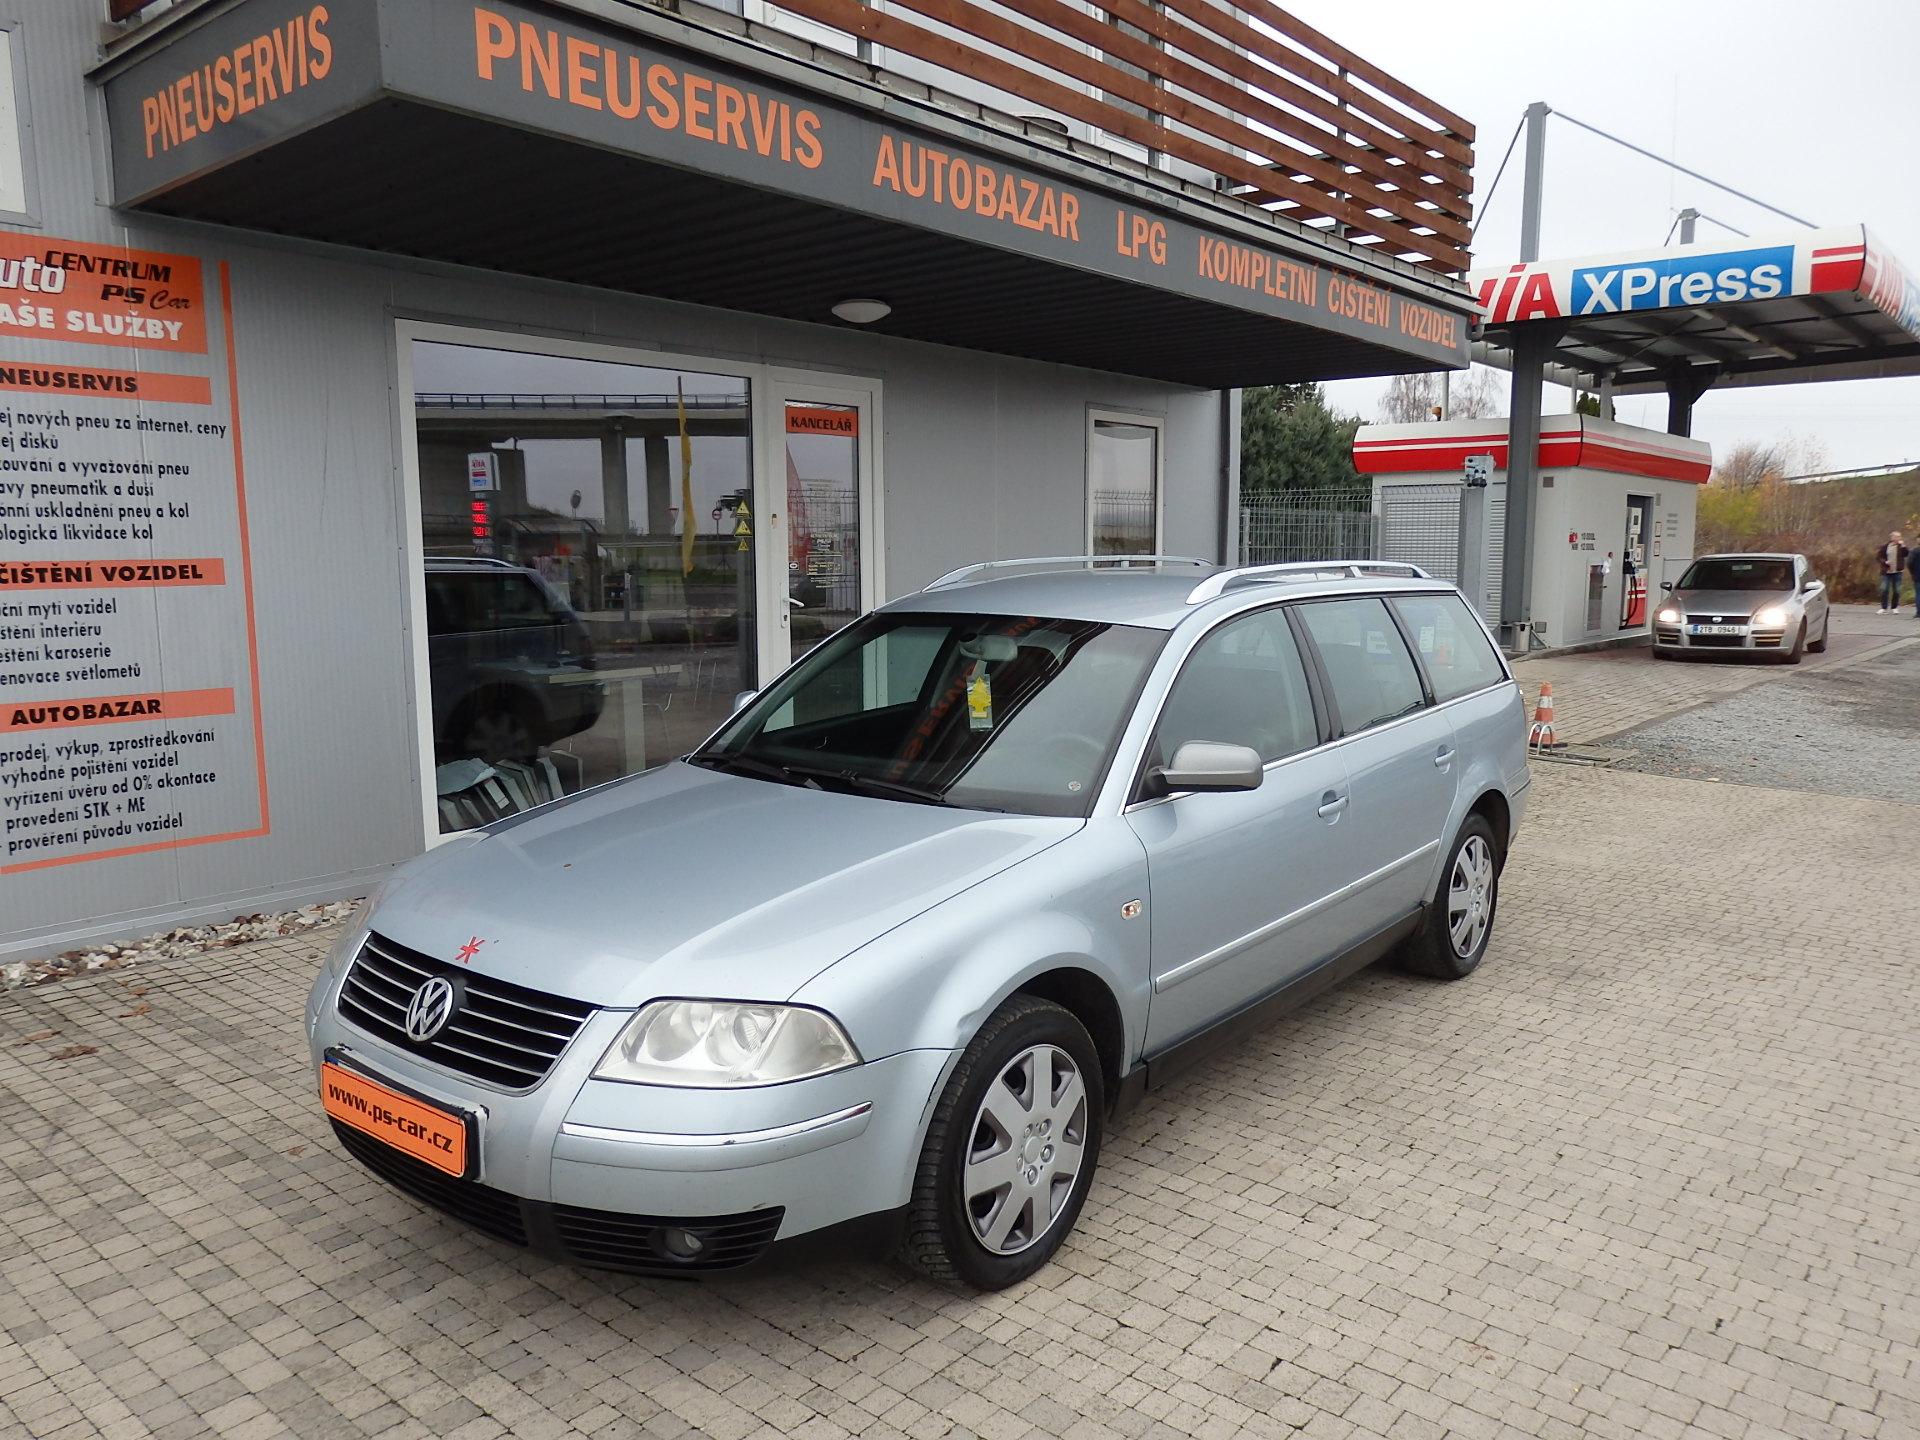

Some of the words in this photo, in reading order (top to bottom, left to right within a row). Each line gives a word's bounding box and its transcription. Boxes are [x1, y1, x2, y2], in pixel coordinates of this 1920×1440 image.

[142, 4, 332, 159] PNEUSERVIS
[474, 7, 823, 169] PNEUSERVIS
[873, 134, 1080, 242] AUTOBAZAR
[1117, 210, 1167, 266] LPG
[1199, 239, 1318, 306] KOMPLETNÍ
[1327, 267, 1391, 329] ČIŠTĚNÍ
[1400, 300, 1457, 350] VOZIDEL
[45, 250, 172, 283] CENTRUM
[100, 284, 147, 304] PS
[150, 289, 191, 310] Car
[1580, 264, 1783, 316] XPress
[66, 310, 183, 341] SLUŽBY
[17, 410, 70, 427] nových
[77, 416, 110, 431] pneu
[115, 420, 131, 430] za
[137, 415, 193, 434] internet.
[197, 423, 227, 438] ceny
[791, 416, 852, 432] KANCELÁŘ
[20, 433, 59, 450] disků
[58, 462, 67, 473] a
[73, 460, 153, 477] vyvažování
[158, 464, 189, 478] pneu
[31, 480, 107, 498] pneumatik
[114, 484, 122, 495] a
[35, 501, 113, 518] uskladnění
[119, 506, 151, 521] pneu
[156, 507, 164, 518] a
[169, 502, 189, 518] kol
[63, 524, 127, 541] likvidace
[132, 524, 153, 540] kol
[101, 565, 203, 582] VOZIDEL
[67, 598, 117, 614] vozidel
[40, 621, 101, 638] interiéru
[44, 642, 111, 660] karoserie
[66, 662, 141, 681] světlometů
[11, 699, 162, 726] AUTOBAZAR
[109, 728, 215, 754] zprostředkování
[2, 765, 65, 788] výhodné
[71, 759, 127, 781] pojištění
[132, 751, 179, 770] vozidel
[4, 787, 63, 810] vyřízení
[69, 784, 107, 800] úvěru
[112, 777, 128, 794] od
[134, 775, 153, 791] 0%
[157, 771, 216, 788] akontace
[6, 808, 79, 834] provedení
[84, 801, 110, 819] STK
[128, 797, 146, 813] ME
[8, 828, 78, 855] prověření
[83, 821, 132, 844] původu
[136, 812, 183, 832] vozidel
[328, 1083, 453, 1154] www.ps-car.cz
